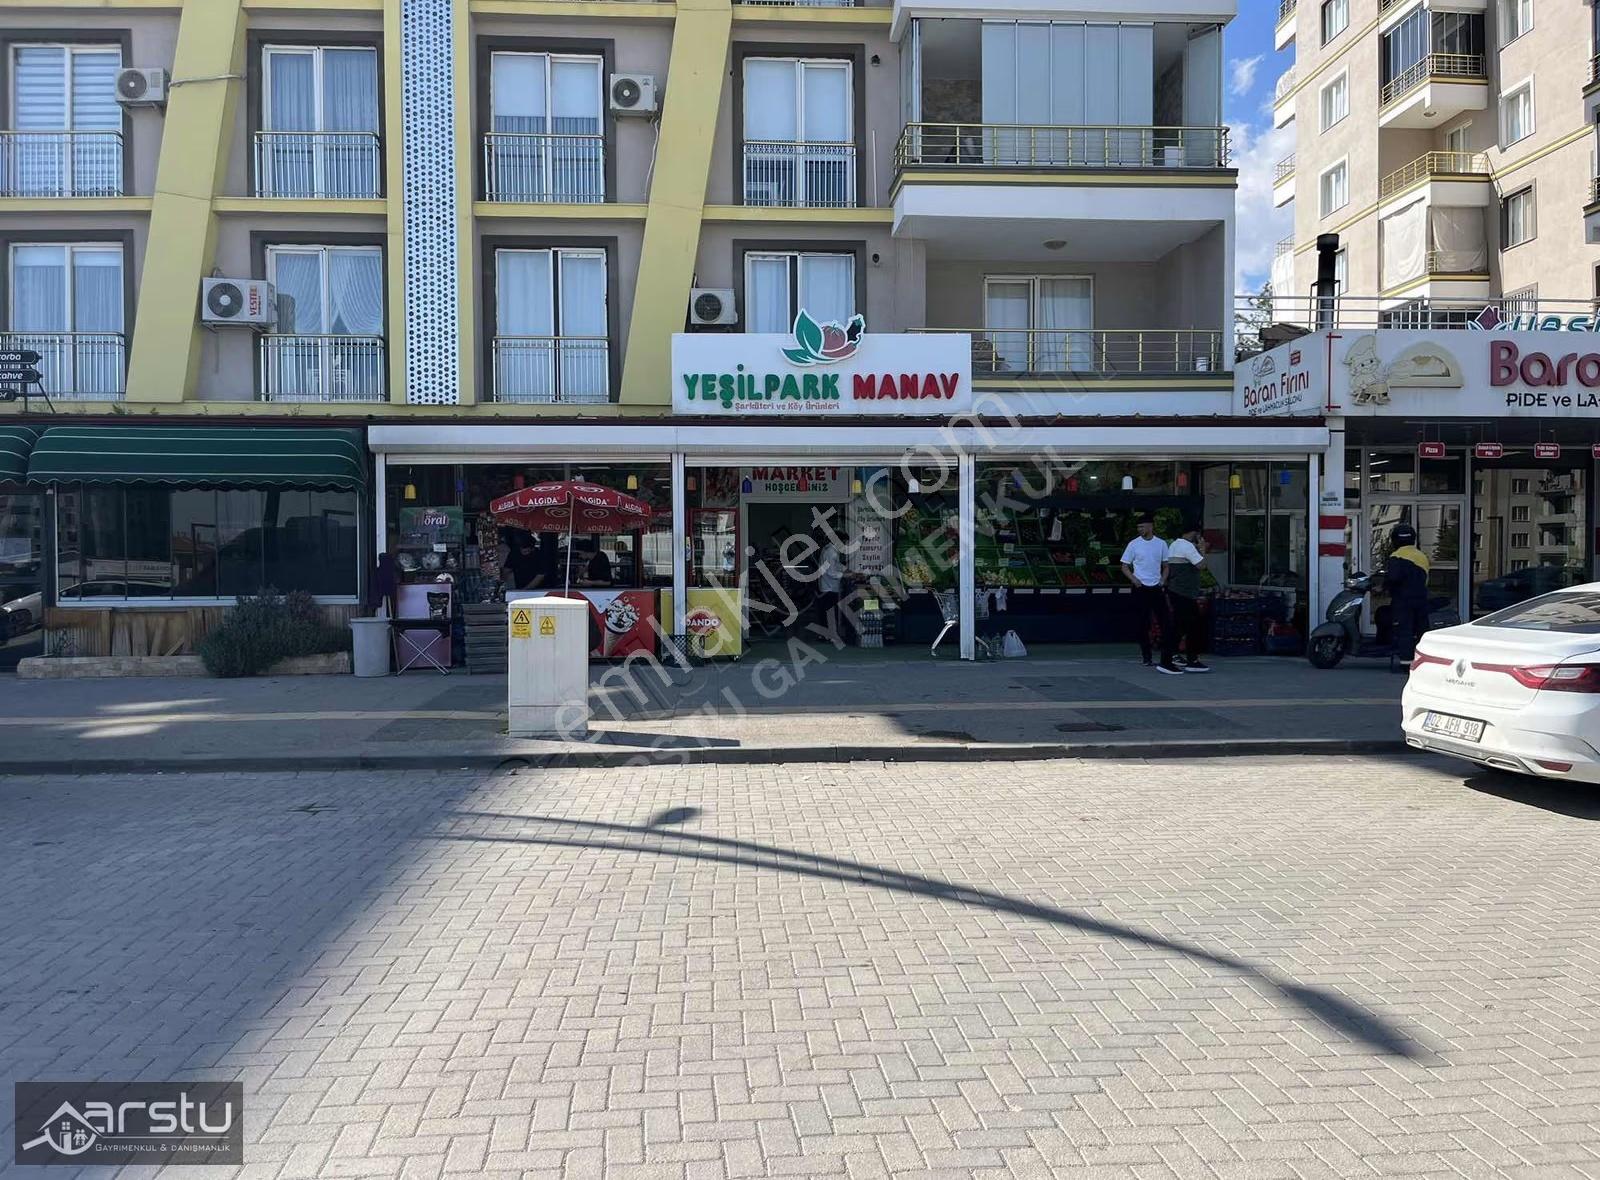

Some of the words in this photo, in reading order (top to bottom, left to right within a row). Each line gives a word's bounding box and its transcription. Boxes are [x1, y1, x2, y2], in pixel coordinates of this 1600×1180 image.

[0, 353, 21, 361] orba
[0, 372, 23, 380] ahve
[683, 364, 840, 408] YEŞİLPARK
[852, 372, 960, 400] MANAV
[1244, 383, 1277, 408] Baran
[1552, 395, 1571, 407] ve
[788, 401, 802, 411] Köy
[752, 466, 839, 480] MARKET
[1430, 713, 1442, 728] 02
[1444, 717, 1462, 732] AFH
[1463, 721, 1480, 736] 918
